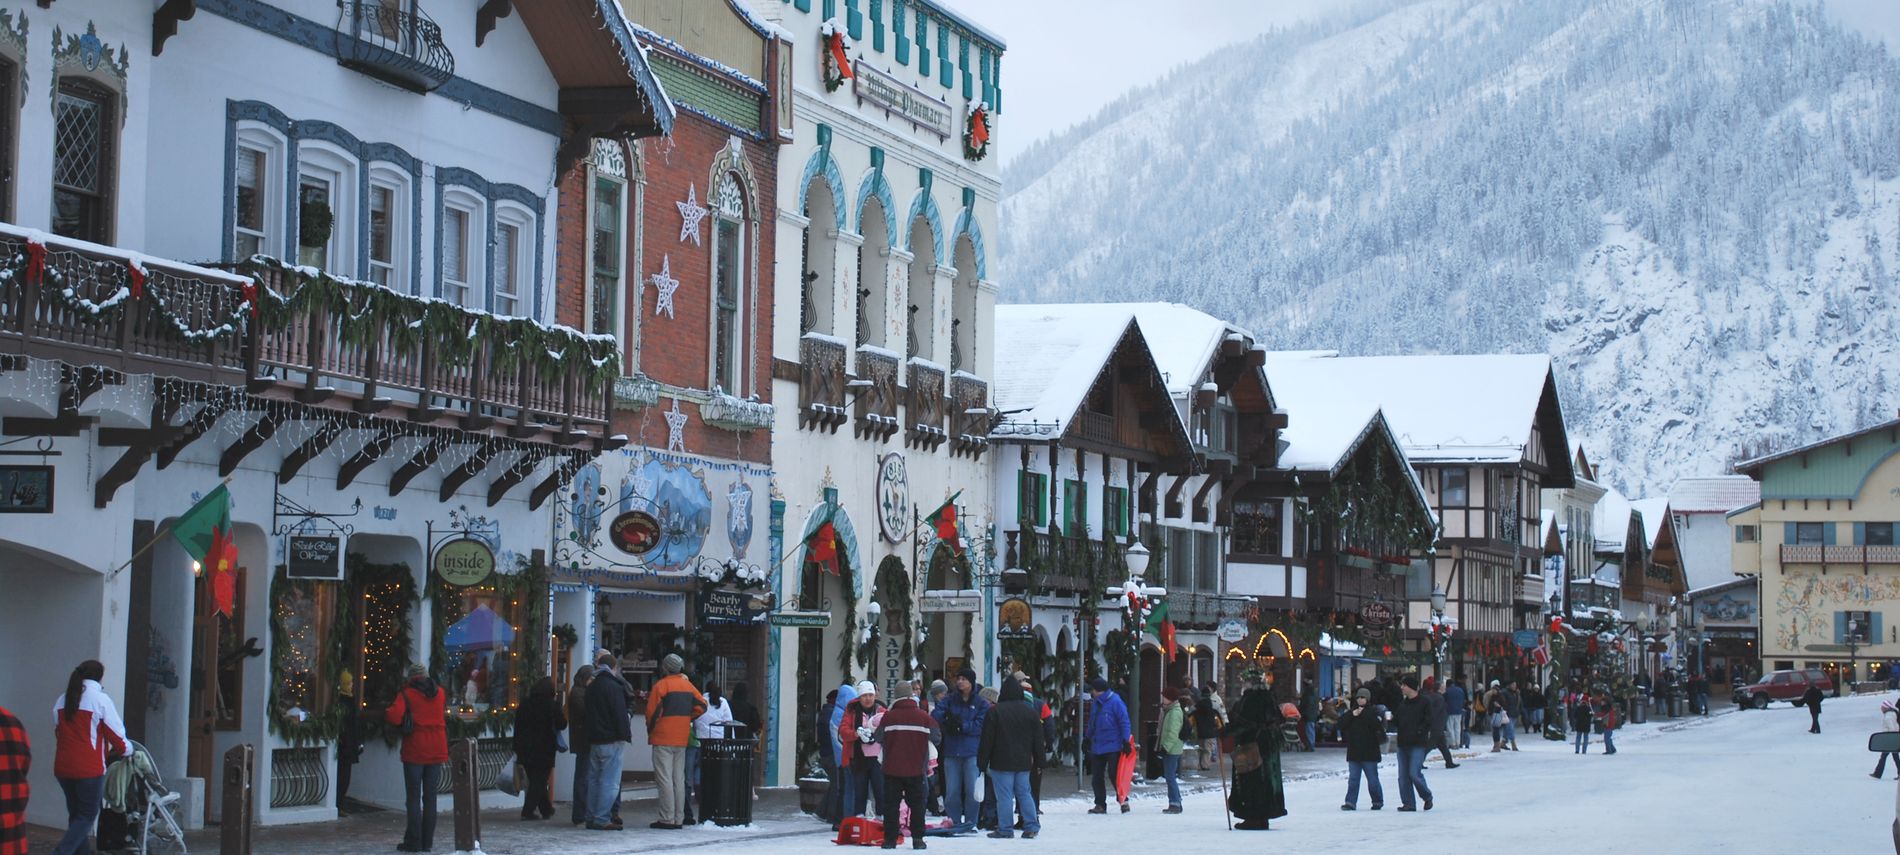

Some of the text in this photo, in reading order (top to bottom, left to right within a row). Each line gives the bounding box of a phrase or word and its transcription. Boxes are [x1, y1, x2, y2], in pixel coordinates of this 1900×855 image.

[865, 73, 943, 129] Village Pharmacy
[300, 551, 329, 563] Winery
[444, 552, 485, 568] inside
[709, 592, 741, 605] Bearly
[923, 600, 944, 609] Village
[772, 616, 791, 624] Village
